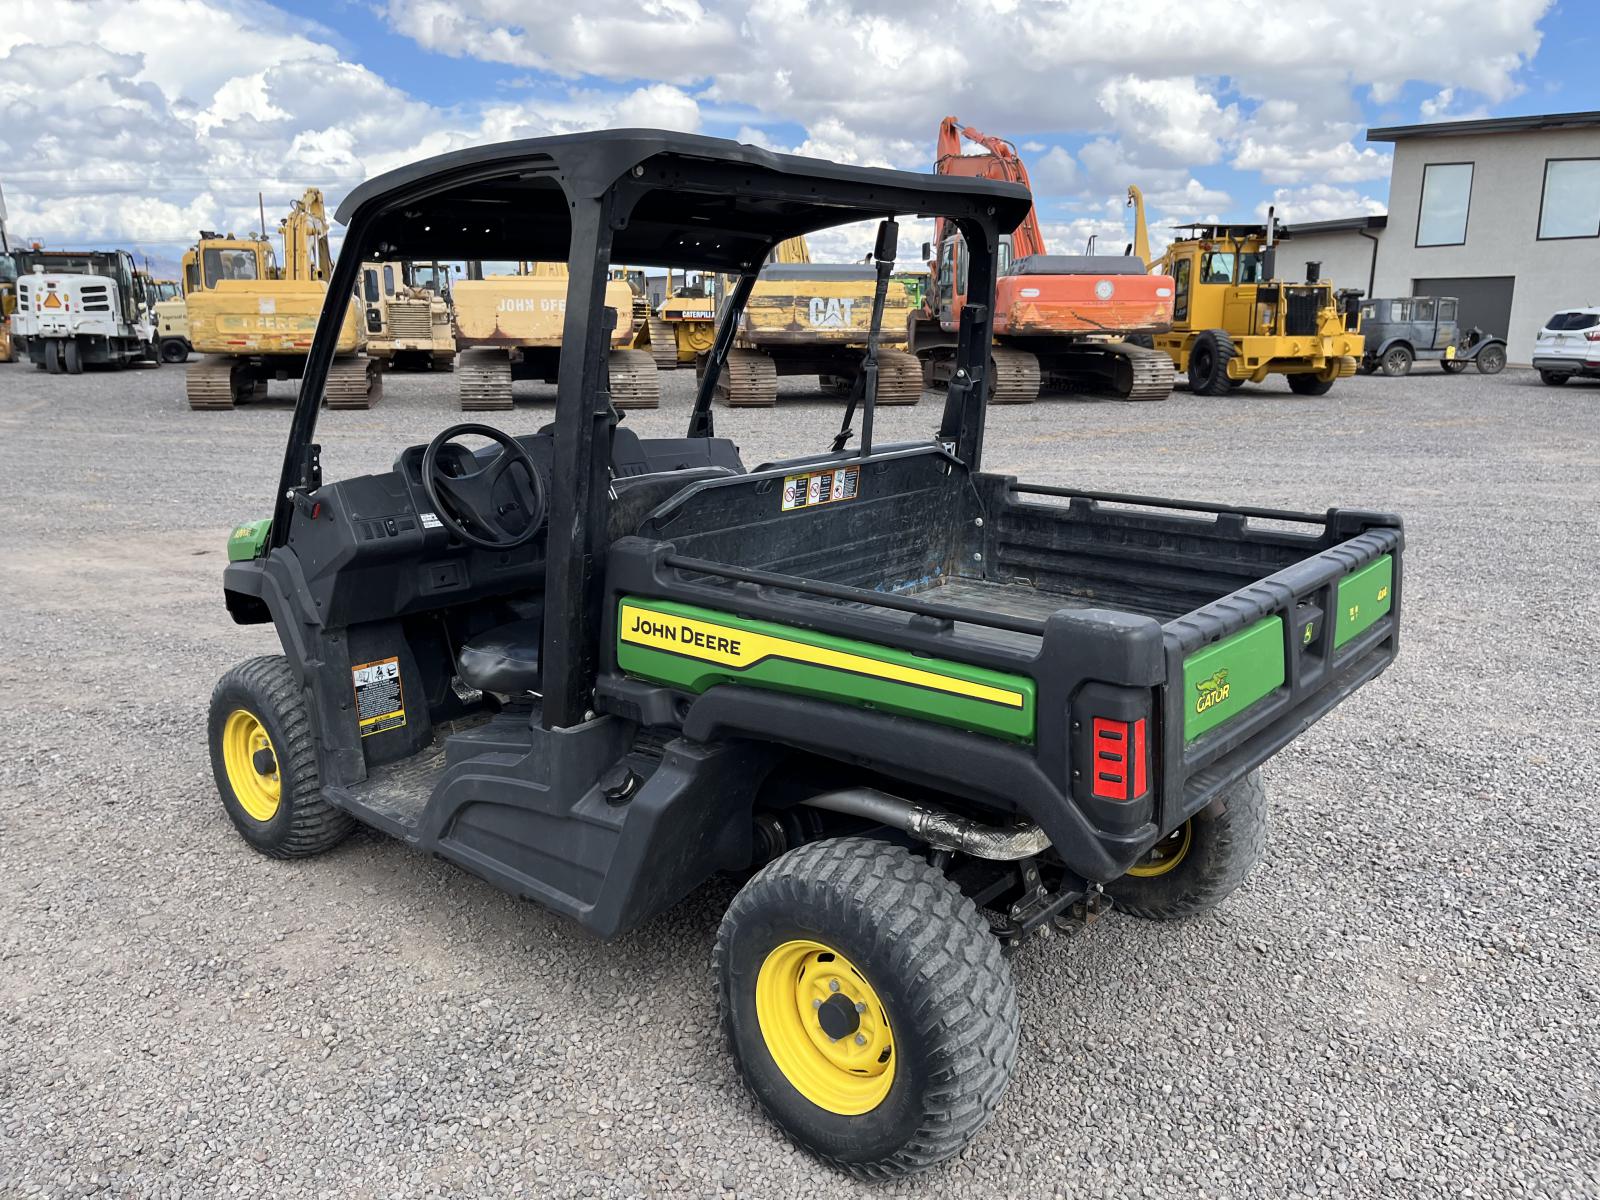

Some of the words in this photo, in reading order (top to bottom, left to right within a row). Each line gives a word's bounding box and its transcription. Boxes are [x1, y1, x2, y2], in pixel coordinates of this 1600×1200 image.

[497, 299, 534, 312] JOHN
[540, 299, 567, 312] DEE
[682, 310, 715, 319] CATERPILLA
[809, 297, 854, 327] CAT
[631, 616, 677, 641] JOHN
[681, 625, 741, 656] DEERE
[1196, 683, 1230, 713] GATOR
